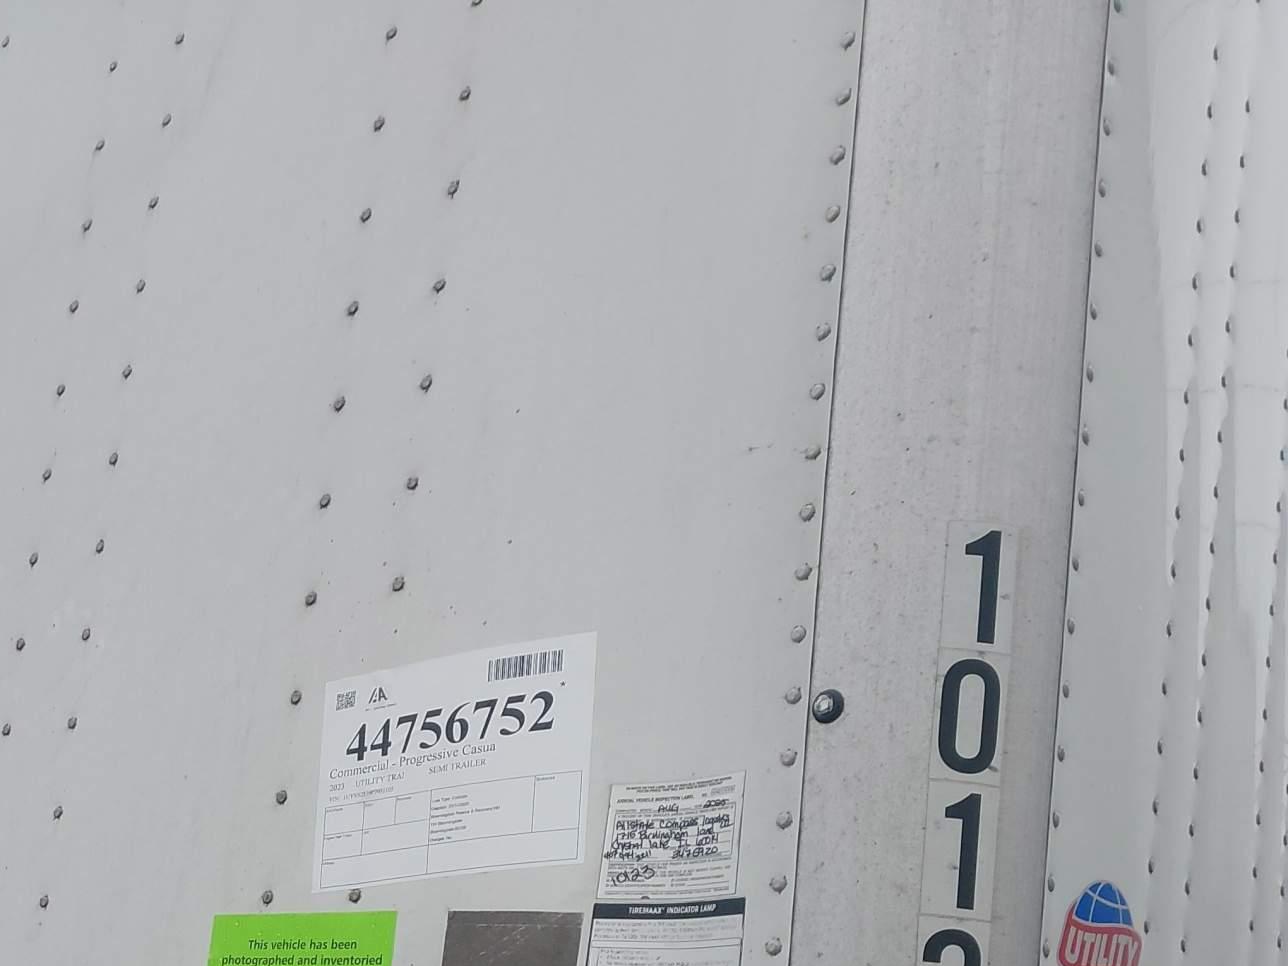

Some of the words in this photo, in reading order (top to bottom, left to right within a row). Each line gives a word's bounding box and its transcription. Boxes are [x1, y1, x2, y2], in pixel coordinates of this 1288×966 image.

[346, 690, 554, 762] 44756752
[329, 759, 389, 780] Commercial
[399, 747, 458, 769] Progressive
[462, 742, 496, 757] Casua
[329, 783, 345, 792] 2023
[355, 776, 386, 788] UTILITY
[428, 764, 449, 775] SEMI
[451, 758, 487, 771] TRAILER
[658, 803, 679, 813] AUG
[667, 905, 699, 914] INDICATOR
[700, 903, 716, 913] LAMP
[248, 940, 268, 950] This
[271, 940, 306, 950] vehicle
[310, 940, 327, 950] has
[331, 940, 357, 950] been
[222, 954, 294, 966] photographed
[297, 955, 317, 965] and
[321, 955, 382, 965] inventoried
